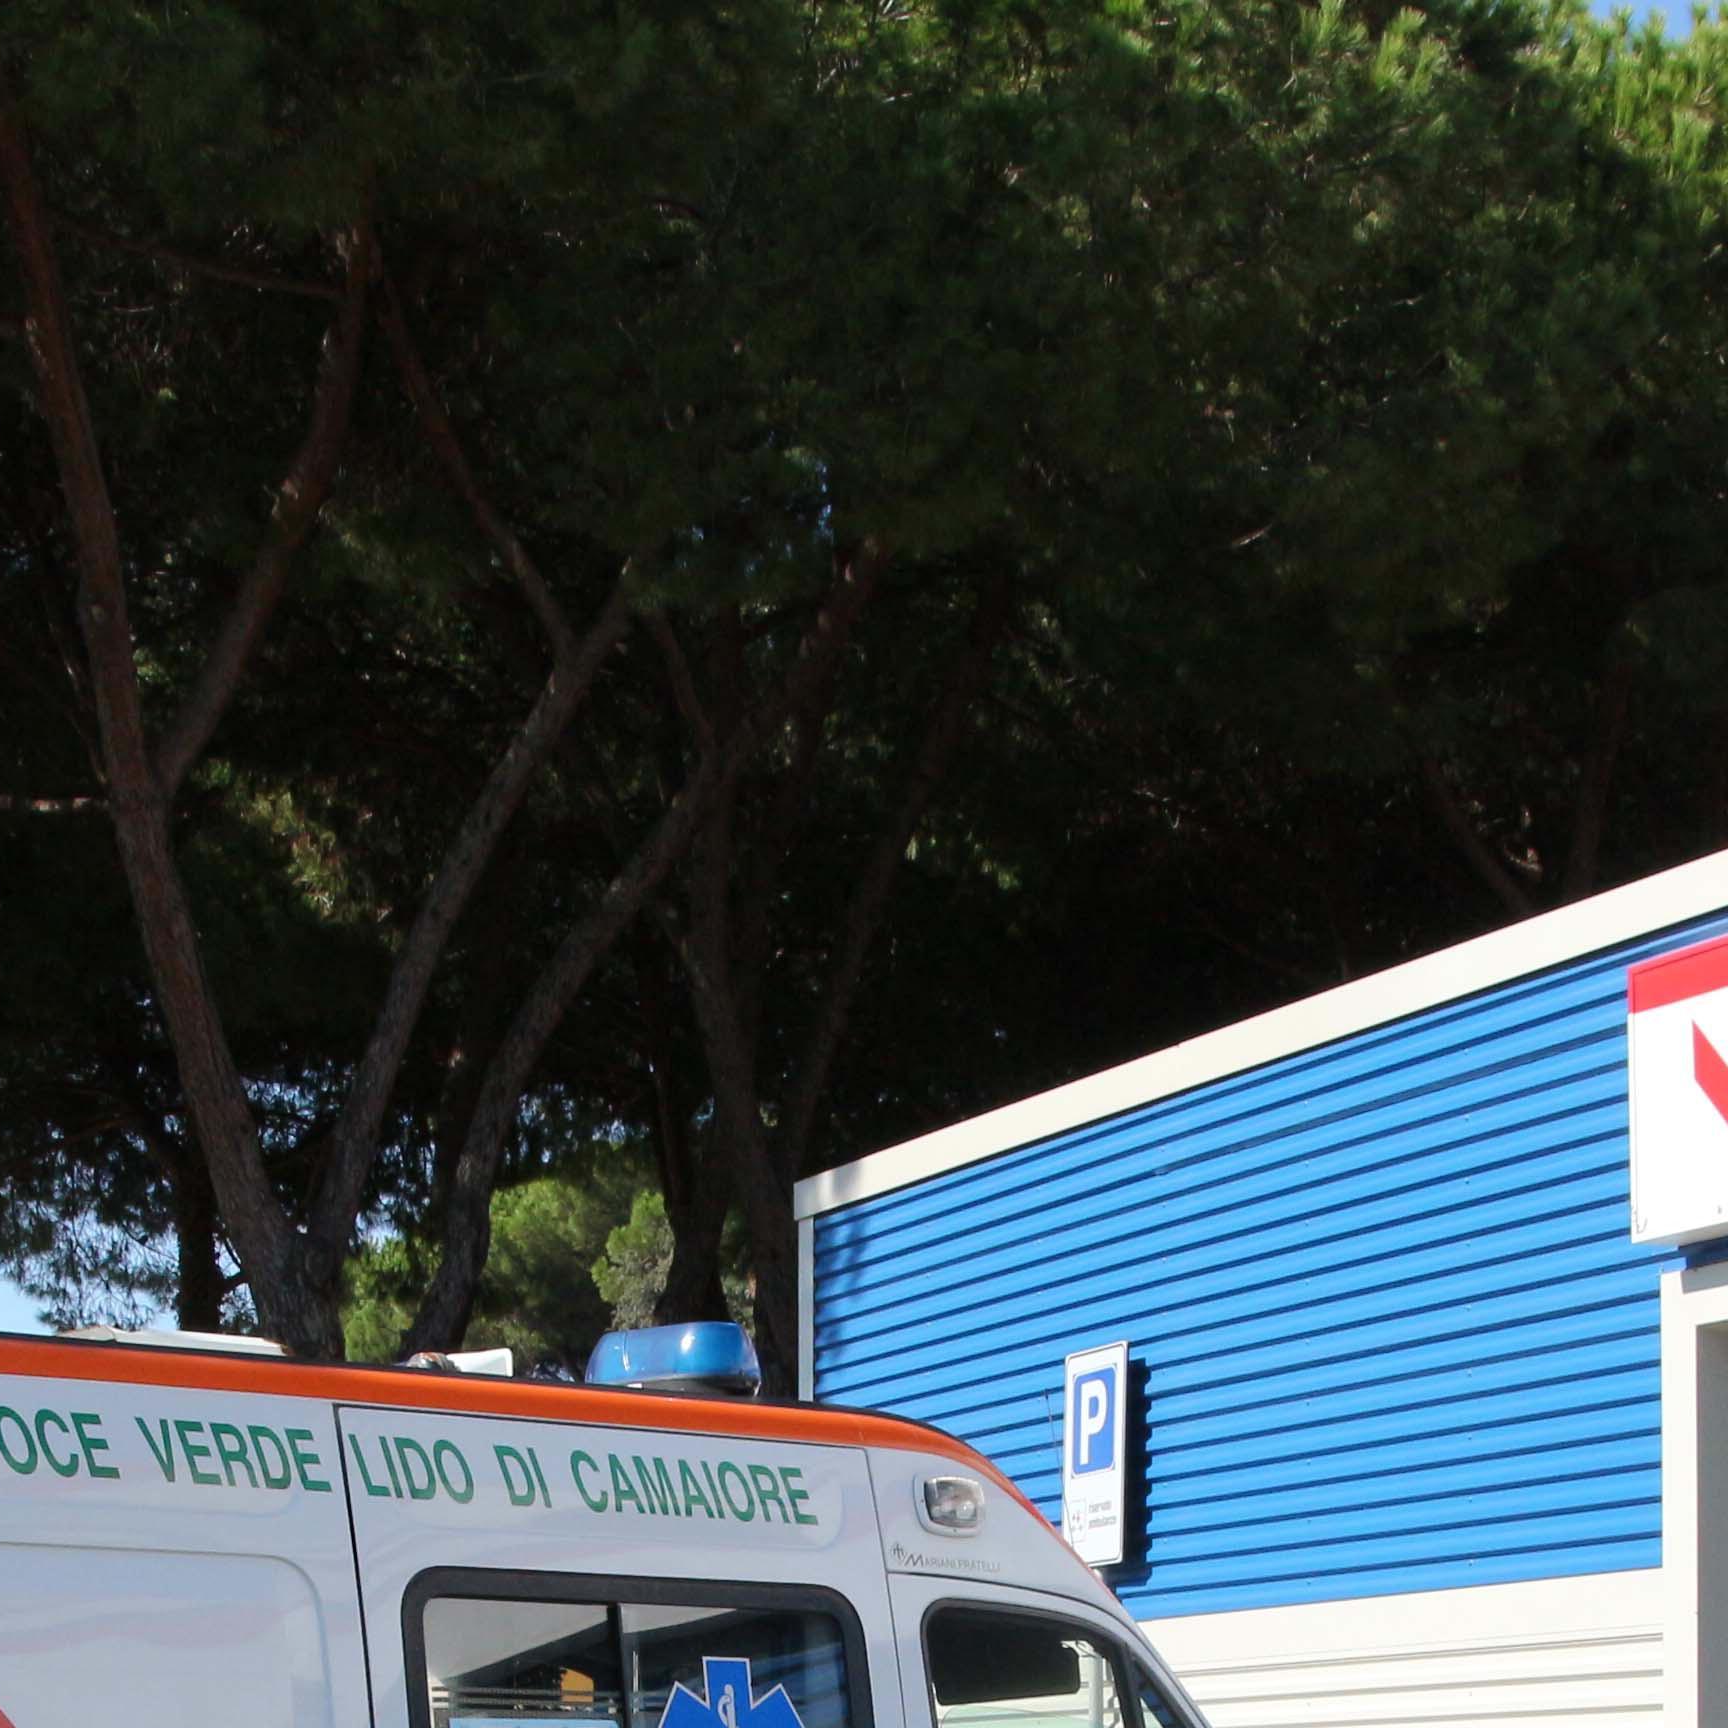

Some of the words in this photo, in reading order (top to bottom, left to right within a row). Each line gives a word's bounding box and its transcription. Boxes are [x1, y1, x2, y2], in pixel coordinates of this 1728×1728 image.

[135, 1416, 332, 1492] VERDE
[348, 1433, 474, 1504] LIDO
[493, 1445, 552, 1508] DI
[571, 1450, 818, 1526] CAMAIORE
[1079, 1378, 1108, 1466] P
